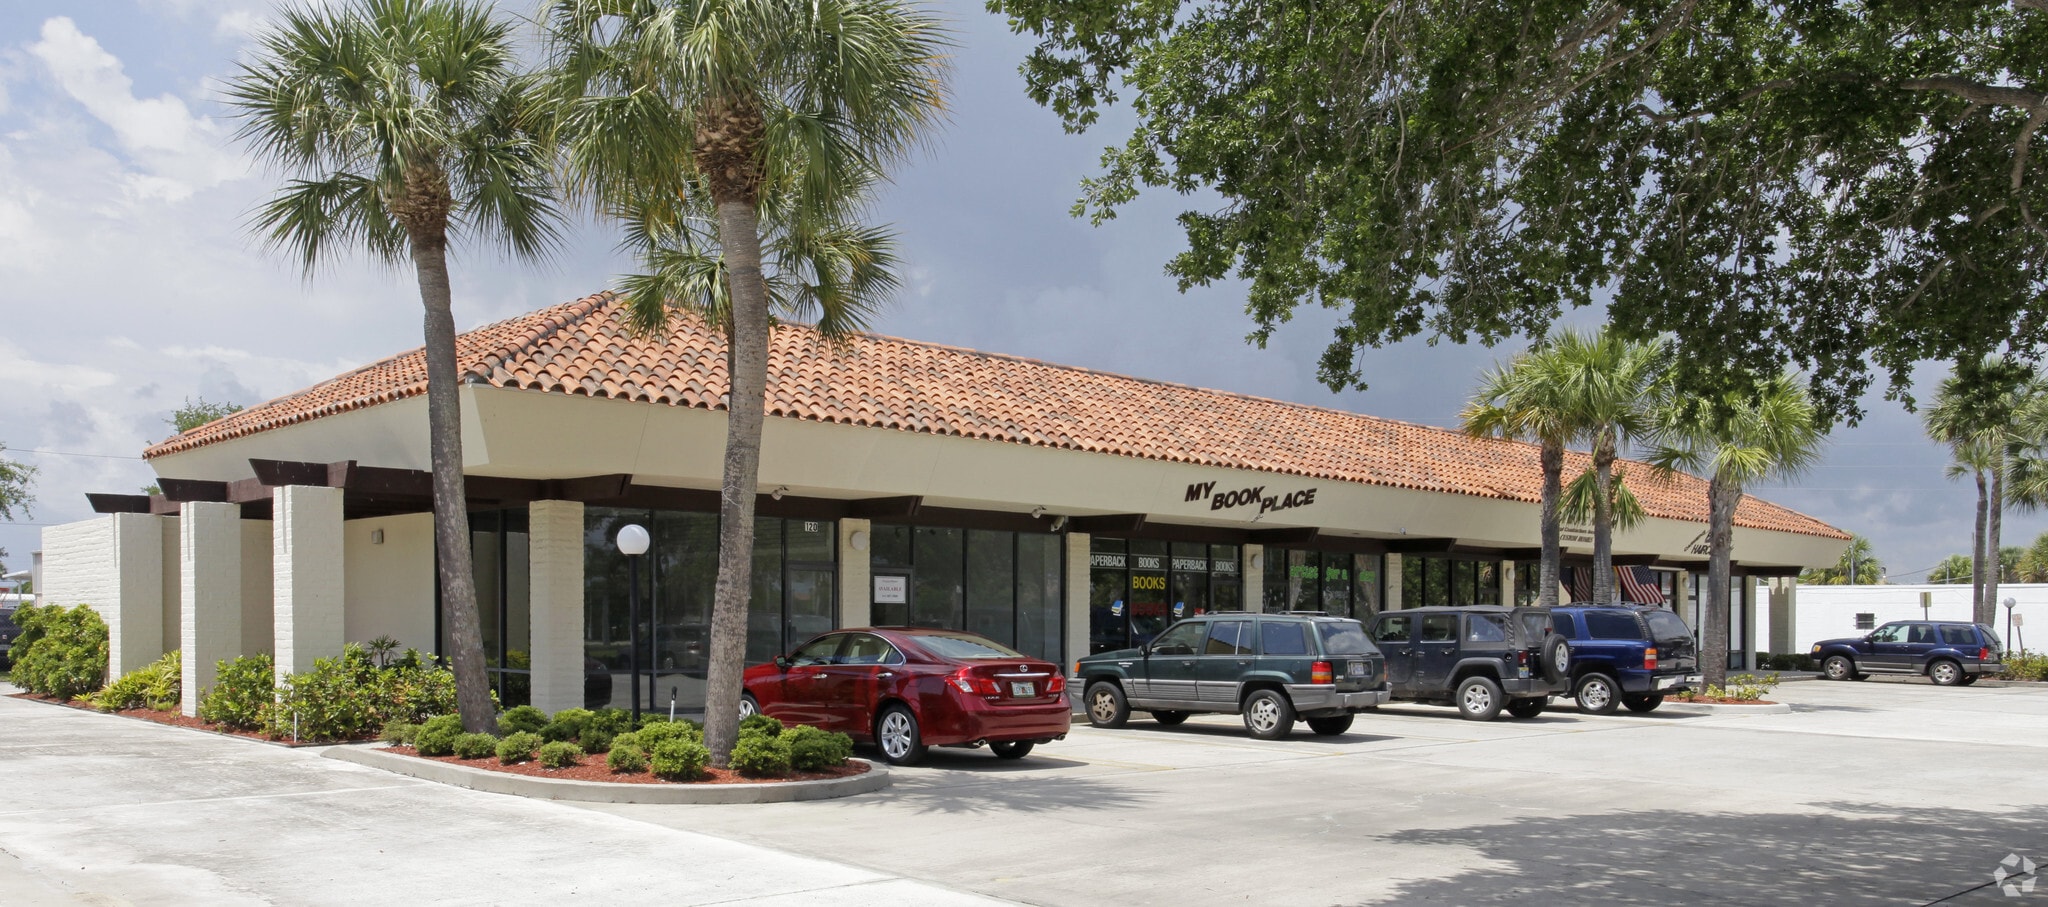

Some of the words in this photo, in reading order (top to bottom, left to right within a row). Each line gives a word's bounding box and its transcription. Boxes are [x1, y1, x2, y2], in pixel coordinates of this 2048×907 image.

[1184, 481, 1216, 502] MY
[1211, 485, 1266, 511] BOOK
[1259, 488, 1317, 514] PLACE
[805, 522, 818, 532] 120
[1090, 554, 1126, 567] APERBACK
[1138, 556, 1160, 569] BOOKS
[1172, 558, 1207, 571] PAPERBACK
[1215, 560, 1235, 572] BOOKS
[1132, 576, 1166, 590] BOOKS
